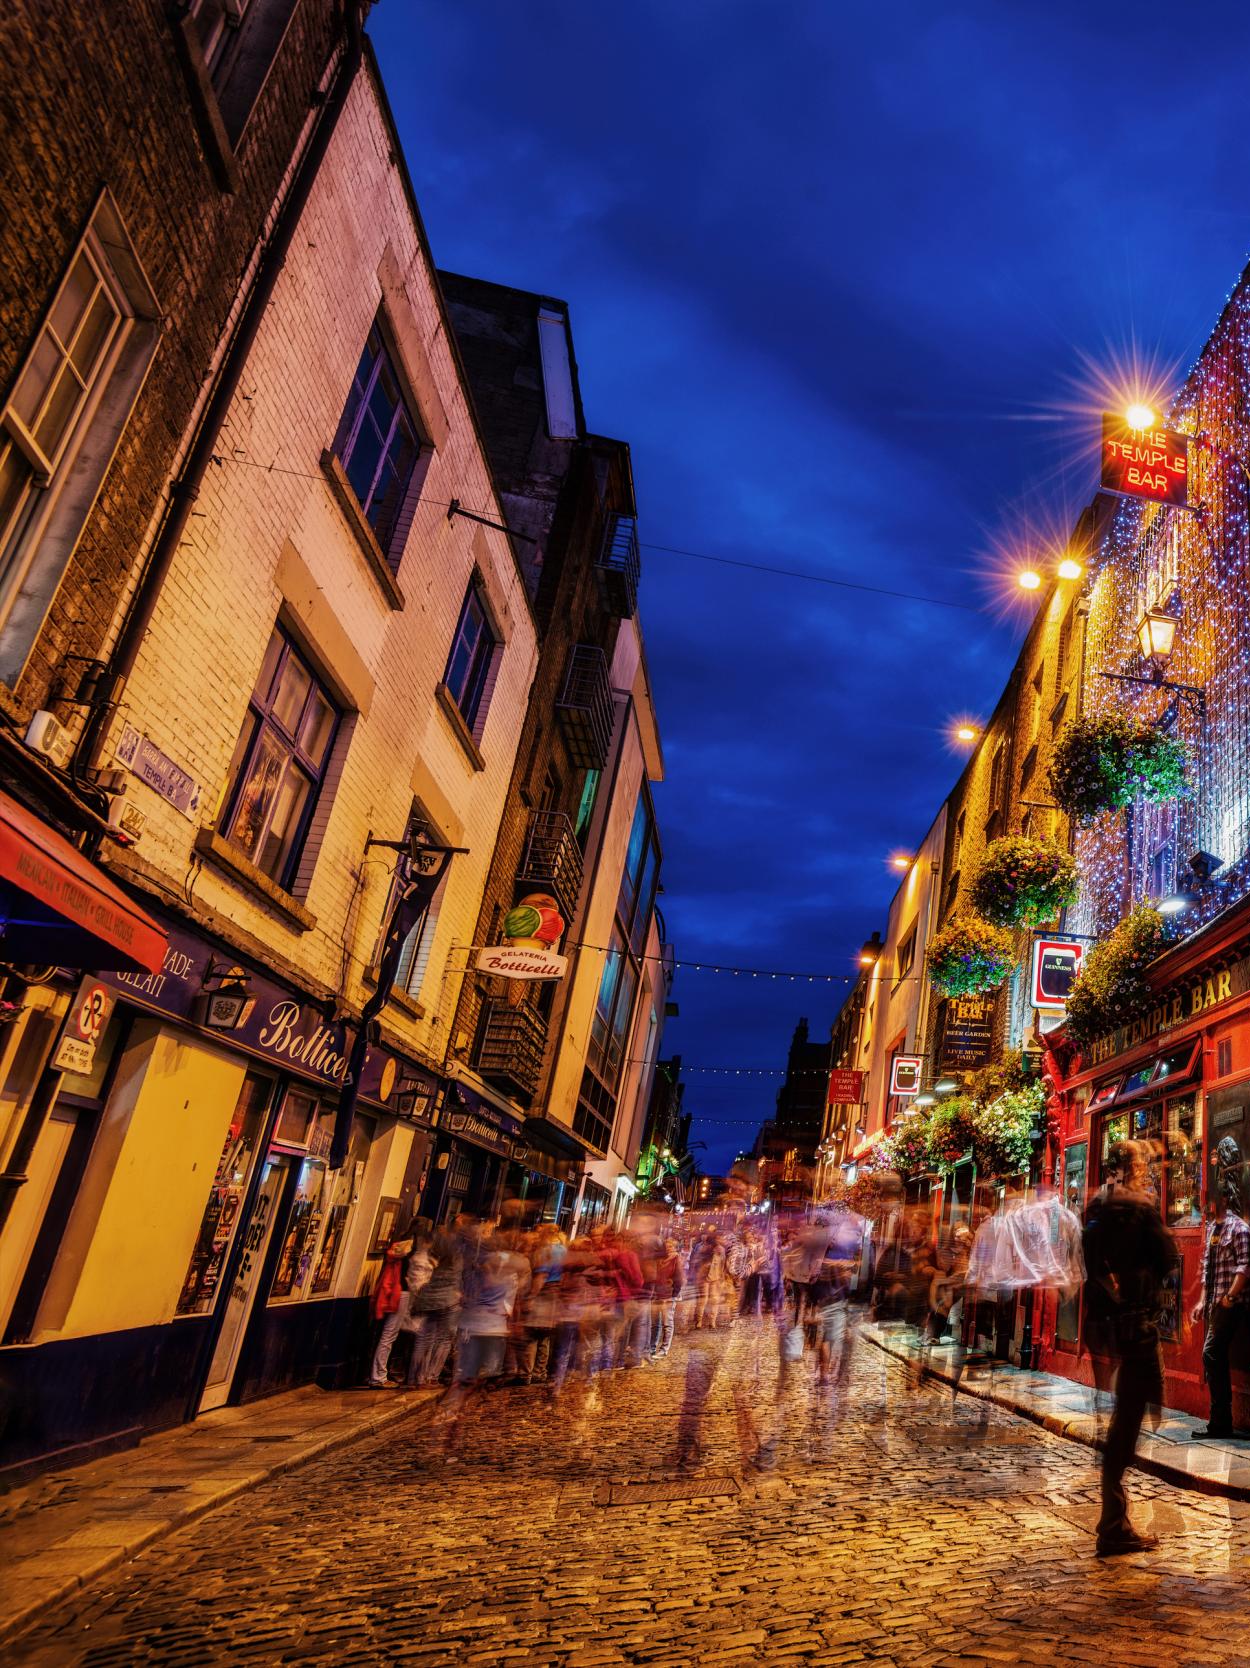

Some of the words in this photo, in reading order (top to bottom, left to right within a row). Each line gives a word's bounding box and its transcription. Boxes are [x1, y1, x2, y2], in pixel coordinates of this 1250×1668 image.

[1131, 428, 1167, 449] THE
[1108, 441, 1186, 474] TEMPLE
[1127, 467, 1167, 492] BAR
[144, 763, 166, 792] TEMPLE
[483, 957, 561, 975] Botticelli
[501, 951, 547, 962] GELATERIA
[949, 999, 994, 1011] TEMPLE
[957, 1007, 983, 1020] BAR
[1090, 1032, 1117, 1065] THE
[1120, 994, 1184, 1051] TEMPLE
[1191, 969, 1232, 1015] BAR
[964, 1030, 992, 1038] GARDEN
